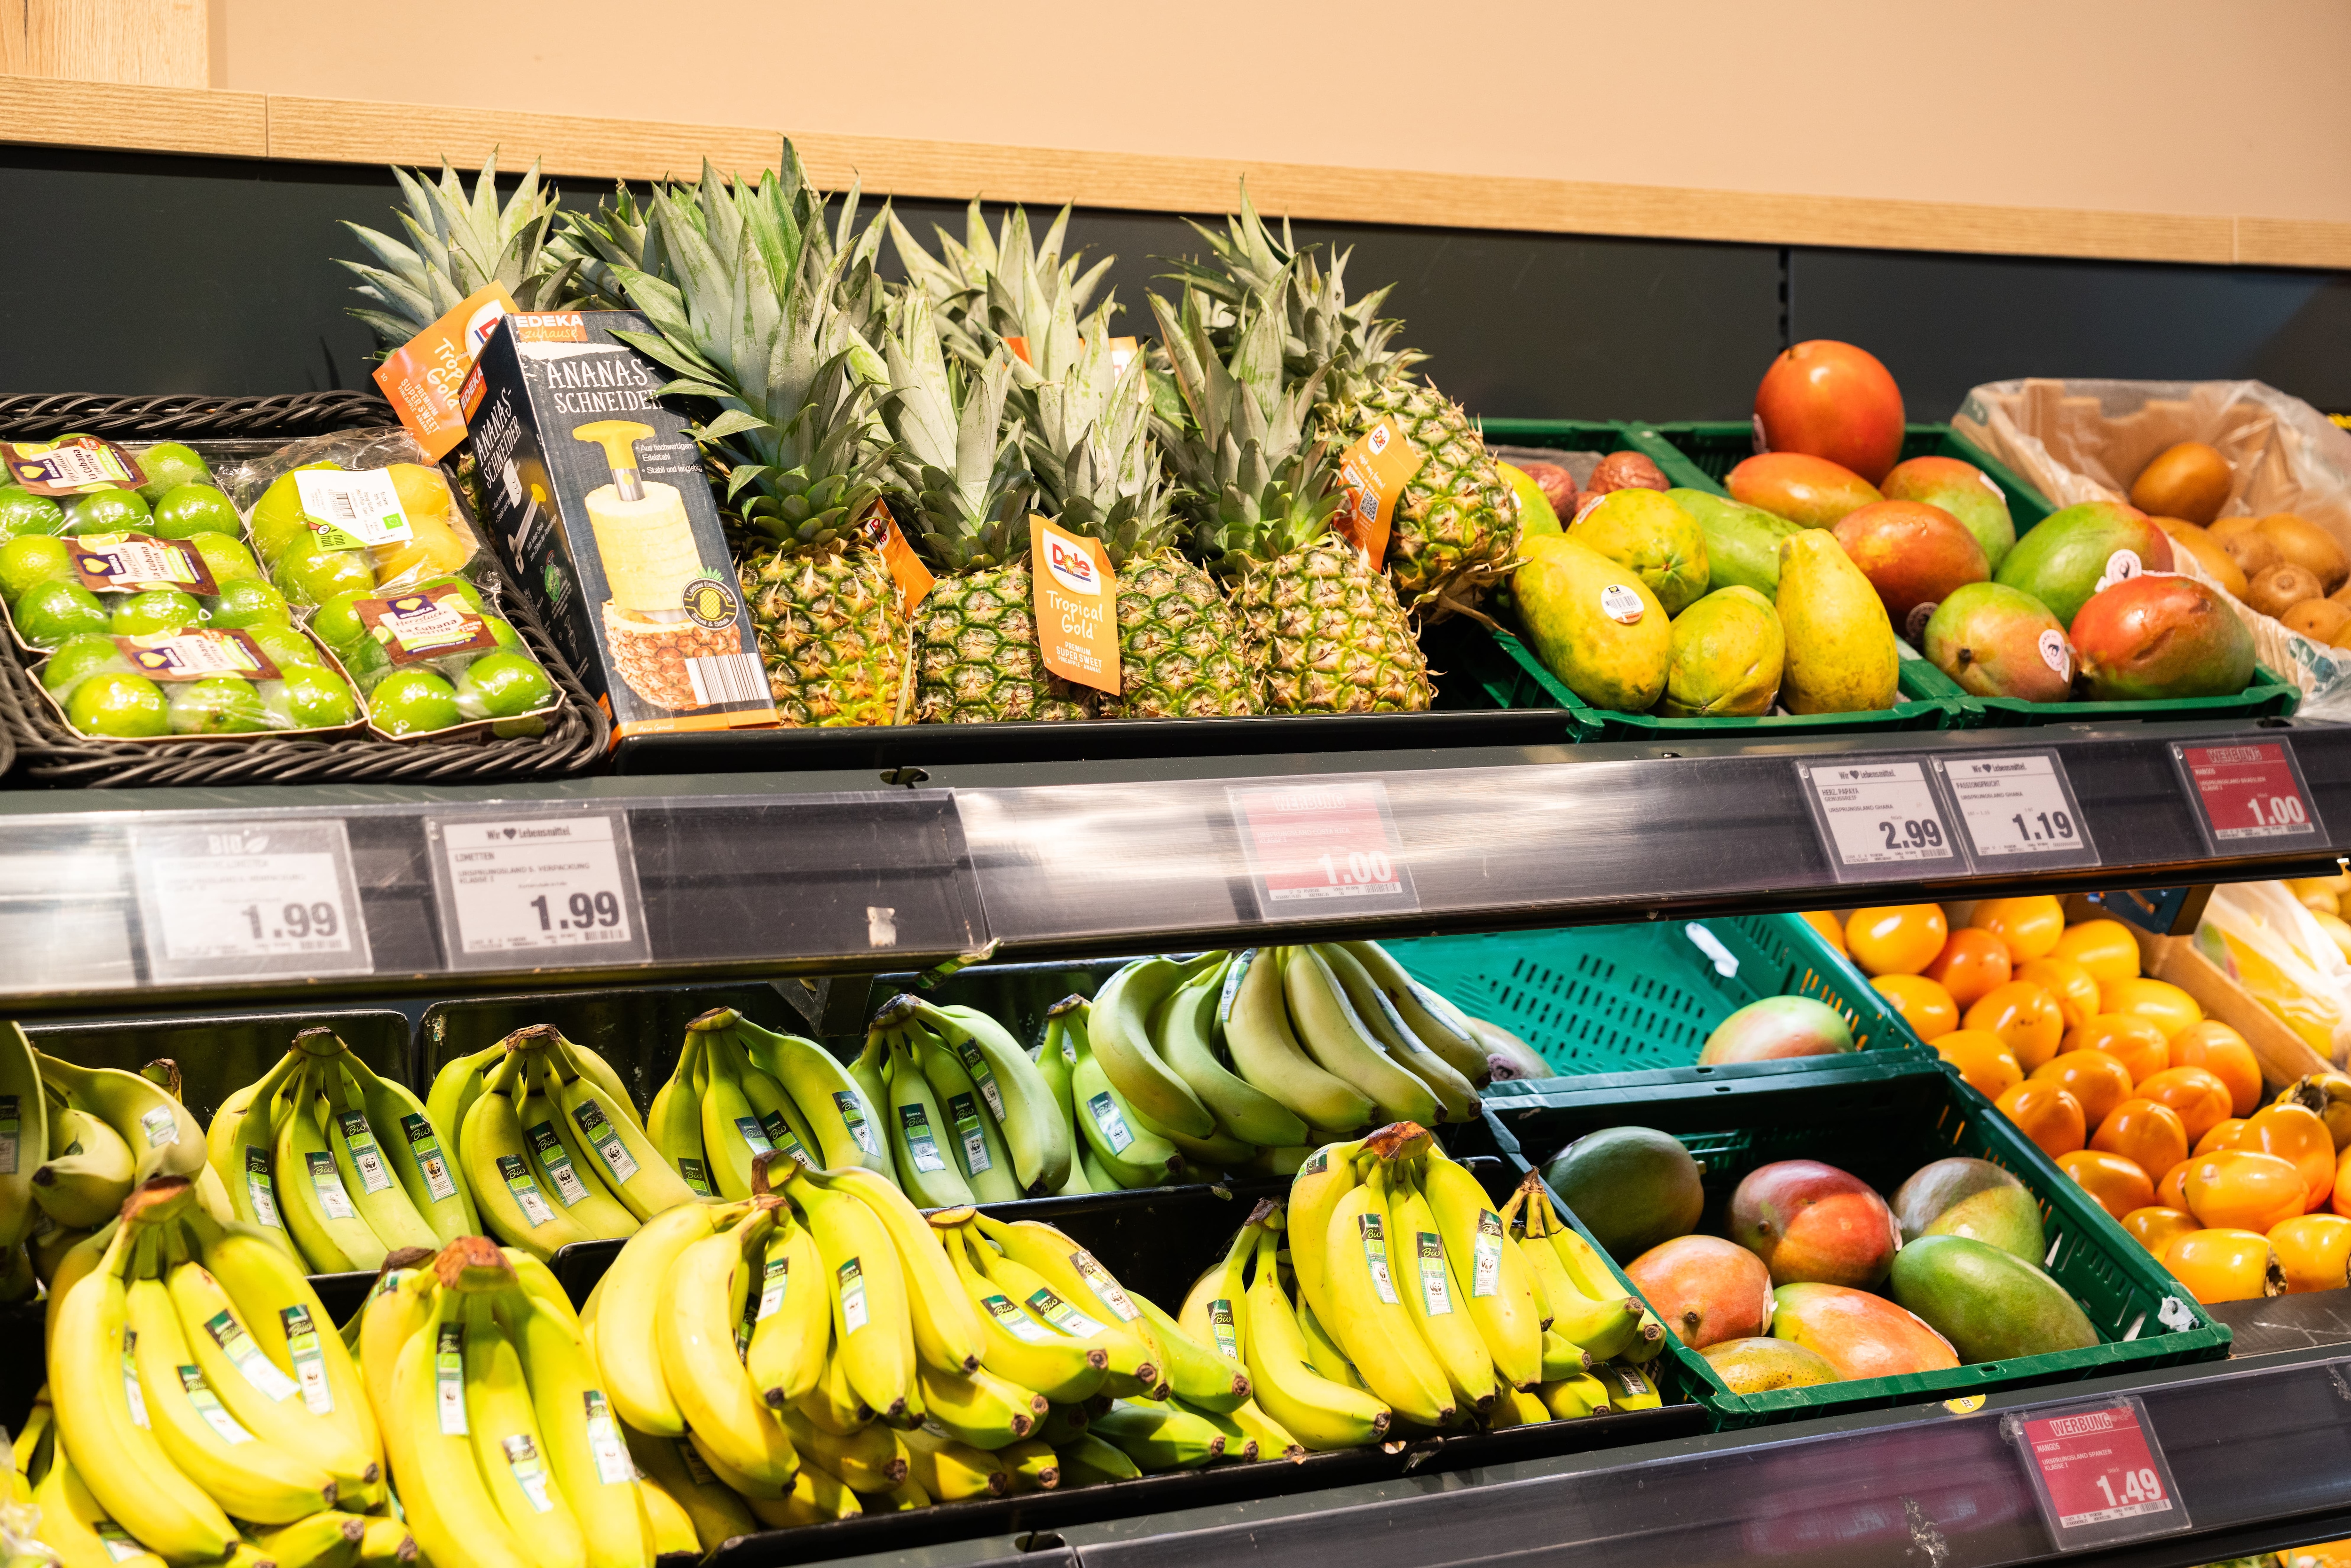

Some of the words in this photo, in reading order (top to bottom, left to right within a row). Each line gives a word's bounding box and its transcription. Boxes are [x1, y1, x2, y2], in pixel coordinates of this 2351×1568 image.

[515, 315, 584, 328] EDEKA
[525, 326, 578, 339] zuhause
[380, 373, 388, 382] 10
[548, 359, 655, 389] ANANAS-
[461, 366, 483, 411] EDEKA
[401, 378, 423, 406] SUPER
[418, 403, 440, 433] SWEET
[414, 384, 439, 417] PREMIUM
[466, 383, 483, 419] zuhause
[554, 389, 663, 413] SCHNEIDER
[397, 386, 417, 412] PINEAPPLE
[416, 414, 432, 435] ANANAS
[476, 387, 512, 467] ANANAS-
[1374, 430, 1386, 447] Dole
[484, 416, 521, 489] SCHNEIDER
[654, 443, 694, 451] hochwertigem
[73, 449, 92, 473] Cubana
[86, 454, 103, 474] LIMETTEN
[320, 536, 334, 547] fruit
[142, 546, 157, 571] Cubana
[1052, 543, 1091, 576] Dole
[687, 582, 703, 596] Leichtes
[704, 581, 728, 596] Entfernen
[1046, 590, 1104, 623] Tropical
[395, 610, 449, 627] Herzstücke
[415, 619, 457, 631] Cubana
[692, 613, 707, 625] Strunk
[714, 618, 730, 627] Schale
[413, 627, 451, 635] LIMETTEN
[1061, 614, 1094, 640] Gold
[1065, 641, 1091, 656] PREMIUM
[1056, 646, 1077, 661] SUPER
[1079, 653, 1102, 668] SWEET
[1058, 655, 1081, 668] PINEAPPLE
[1083, 663, 1101, 674] ANANAS
[2206, 746, 2263, 764] WERBUNG
[1956, 780, 2000, 789] PASSIONSFRUCHT
[1272, 793, 1346, 812] WERBUNG
[2248, 796, 2305, 826] 1.00
[2012, 811, 2073, 841] 1.19
[486, 830, 501, 840] Wir
[1257, 829, 1312, 838] URSPRUNGSLAND
[1879, 819, 1942, 849] 2.99
[208, 834, 243, 854] BIO
[455, 851, 495, 862] LIMETTEN
[458, 867, 527, 877] URSPRUNGSLAND
[538, 863, 590, 872] VERPACKUNG
[1318, 851, 1392, 884] 1.00
[530, 891, 620, 931] 1.99
[241, 901, 339, 939] 1.99
[968, 1050, 981, 1064] Bio
[957, 1109, 974, 1119] Bio
[1097, 1104, 1113, 1117] Bio
[584, 1113, 602, 1130] Bio
[767, 1121, 780, 1130] EDEKA
[907, 1118, 925, 1127] Bio
[347, 1124, 366, 1135] Bio
[411, 1127, 430, 1140] Bio
[536, 1131, 551, 1141] EDEKA
[746, 1129, 762, 1138] Bio
[770, 1126, 786, 1140] Bio
[537, 1136, 556, 1150] Bio
[613, 1153, 623, 1163] WWF
[250, 1163, 267, 1172] Bio
[314, 1166, 333, 1174] Bio
[507, 1168, 525, 1179] Bio
[686, 1171, 702, 1179] Bio
[1367, 1229, 1381, 1238] Bio
[1482, 1224, 1501, 1235] Bio
[1421, 1247, 1440, 1258] Bio
[994, 1304, 1013, 1315] Bio
[1040, 1299, 1058, 1313] Bio
[1215, 1314, 1231, 1324] Bio
[2050, 1412, 2113, 1437] WERBUNG
[2037, 1442, 2060, 1453] MANGOS
[2042, 1452, 2088, 1465] URSPRUNGSLAND
[2088, 1449, 2113, 1458] SPANIEN
[2044, 1463, 2064, 1471] KLASSE
[2096, 1468, 2162, 1506] 1.49
